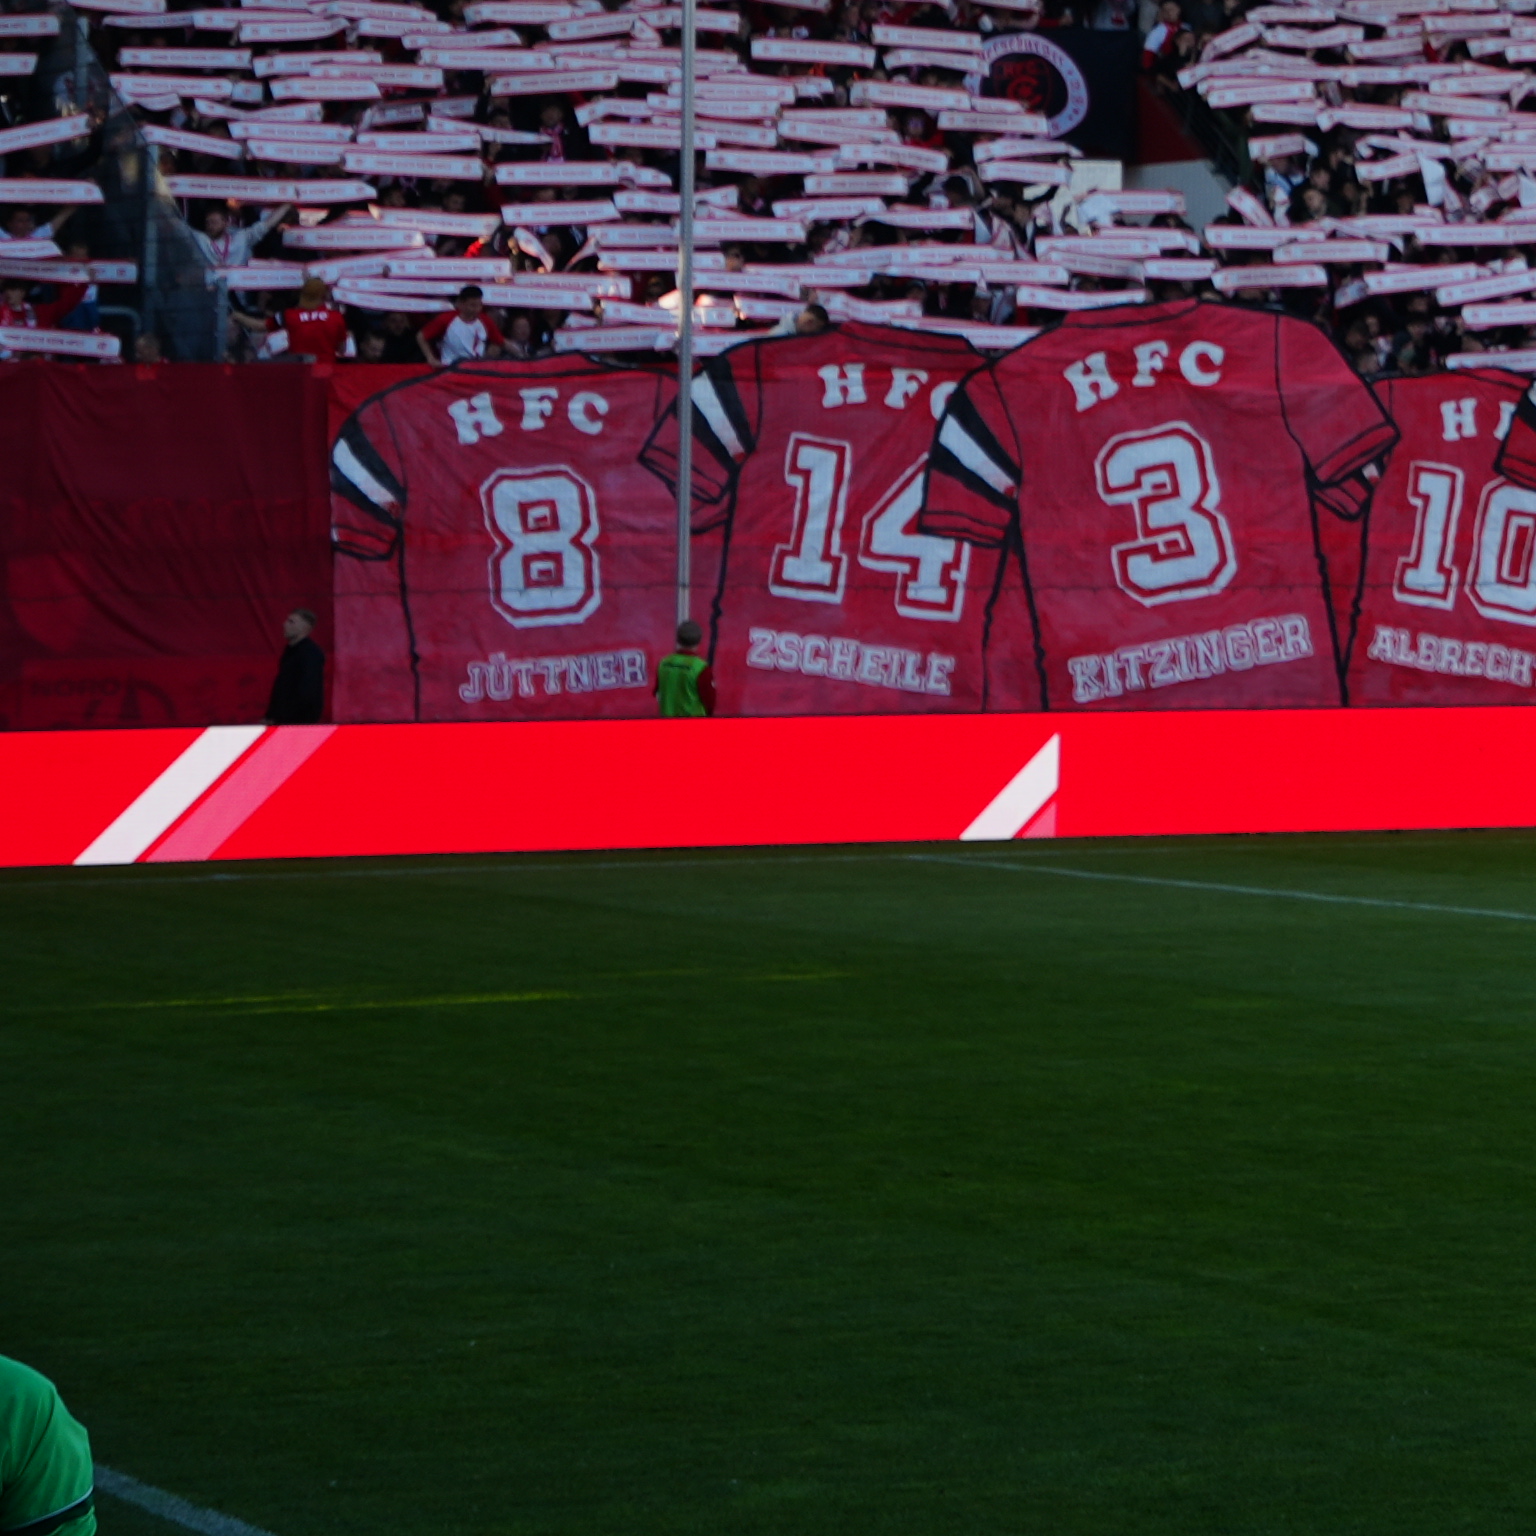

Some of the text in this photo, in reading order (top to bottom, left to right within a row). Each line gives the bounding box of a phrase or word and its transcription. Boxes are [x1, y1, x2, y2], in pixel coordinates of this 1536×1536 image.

[1062, 340, 1225, 412] HFC
[447, 387, 610, 445] HFC
[479, 464, 601, 629] 8
[768, 431, 969, 622] 14
[1094, 419, 1238, 608] 3
[459, 648, 648, 704] JÜTTNER
[746, 627, 955, 696] ZSCHEILE
